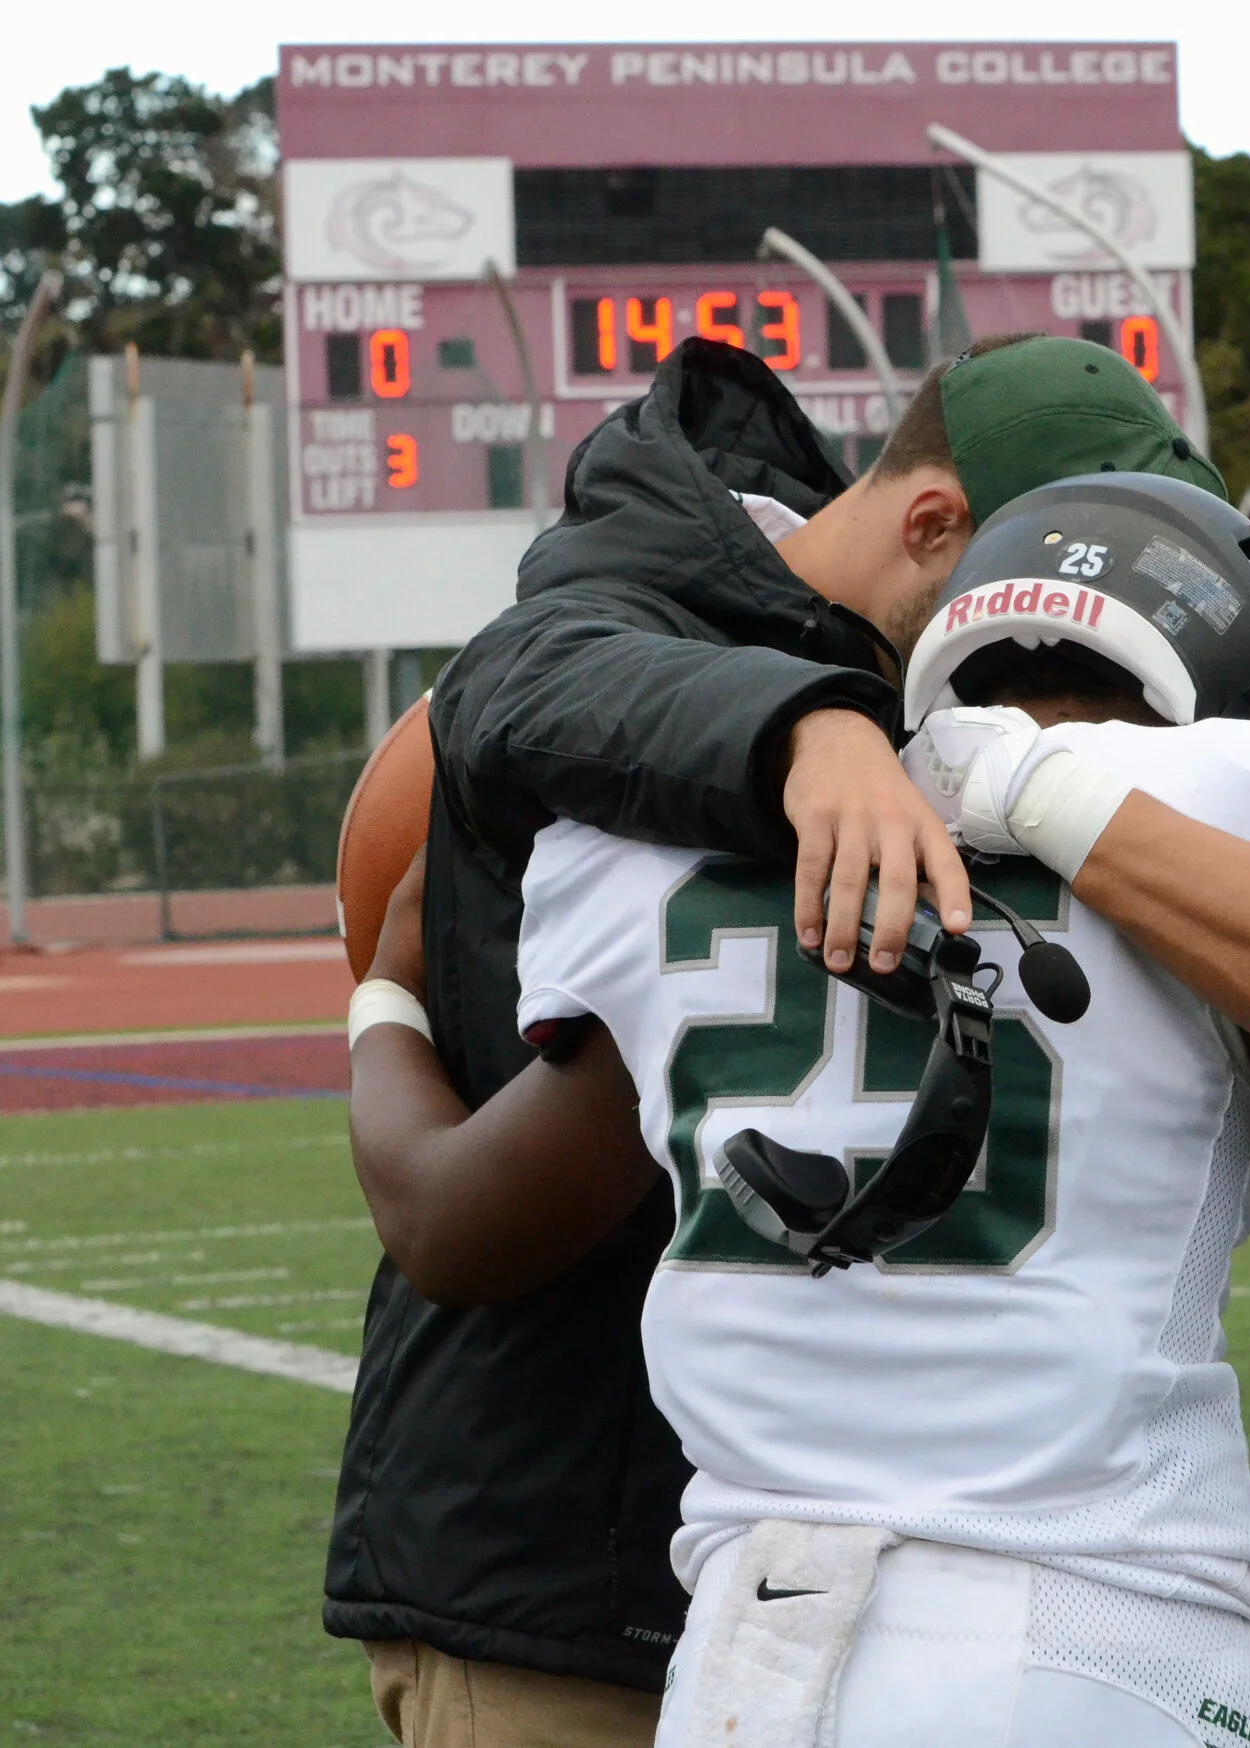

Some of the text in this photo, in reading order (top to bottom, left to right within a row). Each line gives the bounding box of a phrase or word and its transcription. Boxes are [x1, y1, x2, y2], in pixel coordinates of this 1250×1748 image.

[291, 50, 1172, 87] MONTEREY PENINSULA COLLEGE
[304, 285, 424, 331] HOME
[369, 328, 410, 398] 0
[1120, 316, 1159, 384] 0
[385, 433, 418, 488] 3
[310, 477, 376, 511] LEFT
[1059, 542, 1108, 578] 25
[944, 582, 1105, 637] Riddell
[951, 982, 986, 1001] PHONE
[955, 990, 989, 1009] PORTA
[655, 853, 1071, 1277] 25
